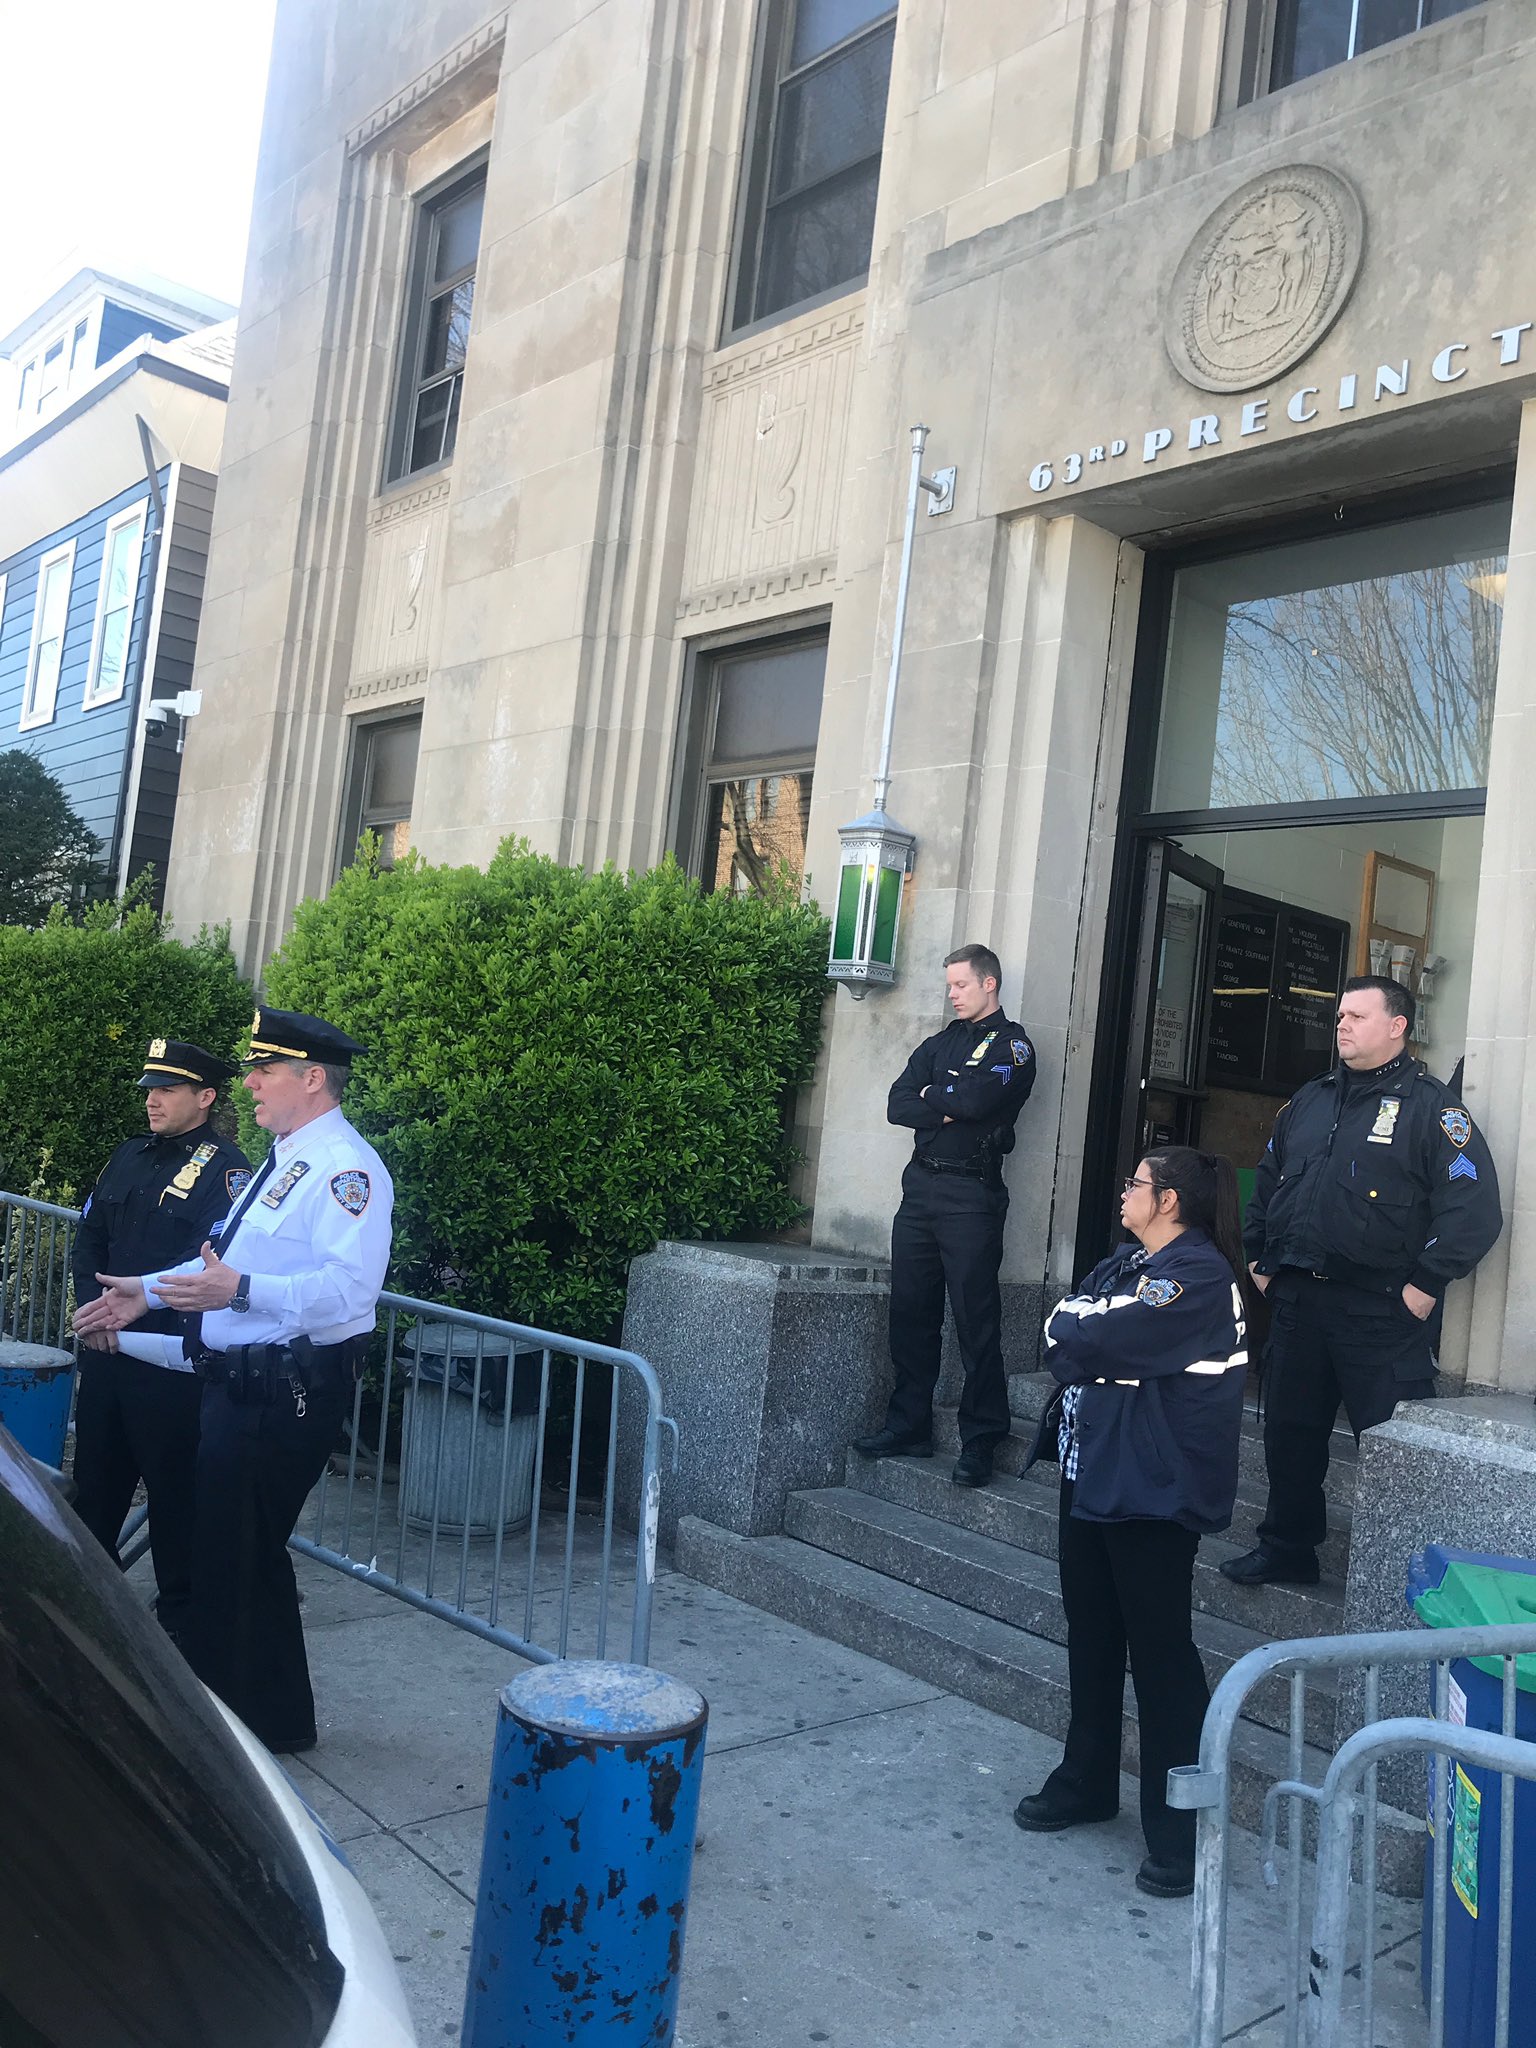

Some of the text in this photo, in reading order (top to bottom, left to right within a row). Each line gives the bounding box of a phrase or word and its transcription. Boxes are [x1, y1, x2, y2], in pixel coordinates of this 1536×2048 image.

[1028, 321, 1533, 493] 63RD PRECINCT
[1158, 1008, 1177, 1019] OF THE
[339, 1171, 360, 1180] POLICE
[333, 1177, 367, 1189] DEPARTMENT
[335, 1192, 346, 1204] CITY
